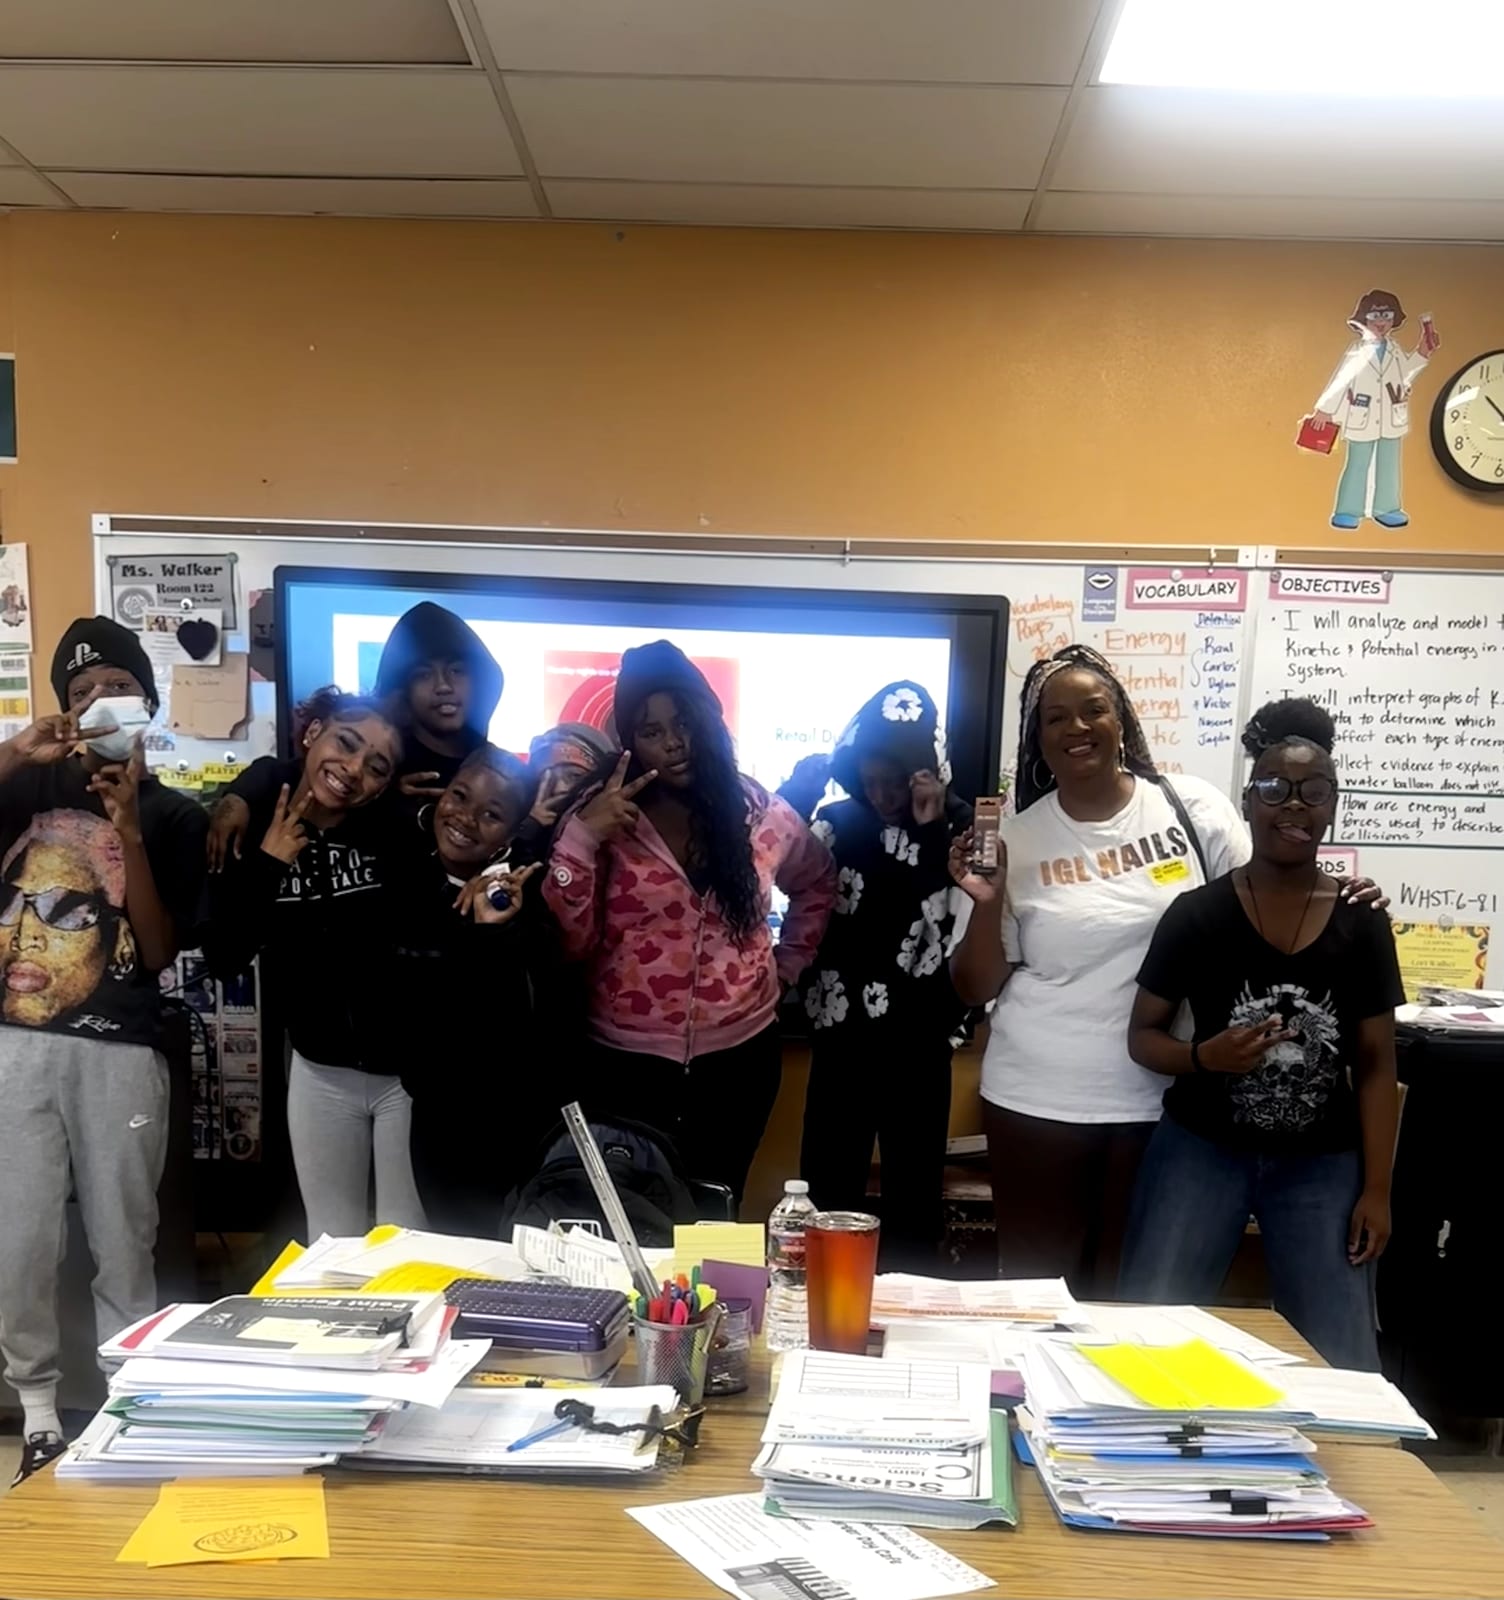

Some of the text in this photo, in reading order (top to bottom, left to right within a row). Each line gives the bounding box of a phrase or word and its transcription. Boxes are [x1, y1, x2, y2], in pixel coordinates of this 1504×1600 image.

[1480, 365, 1490, 379] 11
[1451, 410, 1460, 424] 9
[1454, 436, 1464, 451] 8
[1470, 455, 1480, 469] 7
[1494, 463, 1504, 478] 6
[122, 563, 223, 577] Ms. Walker
[157, 583, 214, 594] Room 122
[1135, 581, 1237, 599] VOCABULARY
[1281, 577, 1381, 595] OBJECTIVES
[1283, 610, 1301, 631] I
[1313, 610, 1340, 630] will
[1348, 612, 1406, 639] analyze
[1412, 616, 1439, 631] and
[1448, 614, 1488, 630] model
[1105, 628, 1186, 656] Energy
[1286, 637, 1341, 657] Kinetic
[1361, 639, 1419, 659] Potential
[1426, 643, 1478, 660] energy
[1482, 641, 1497, 652] in
[1111, 663, 1185, 693] otential
[1348, 686, 1415, 709] interpret
[1419, 691, 1462, 711] graphs
[1465, 687, 1480, 706] of
[1131, 698, 1180, 722] nergy
[1359, 713, 1373, 724] to
[1380, 710, 1446, 726] determine
[1455, 714, 1496, 729] which
[776, 728, 816, 742] Retail
[1333, 729, 1376, 743] affect
[1385, 732, 1416, 746] each
[1422, 733, 1450, 751] type
[1454, 730, 1469, 747] of
[1333, 753, 1499, 777] ollect evidence to explain
[1345, 775, 1388, 788] water
[1394, 777, 1434, 790] balloon
[1440, 778, 1462, 791] does
[1465, 779, 1480, 791] not
[1342, 793, 1486, 820] How are energy and
[1341, 811, 1503, 833] forces used to describe
[1096, 826, 1188, 879] NAILS
[790, 1469, 944, 1494] Science
